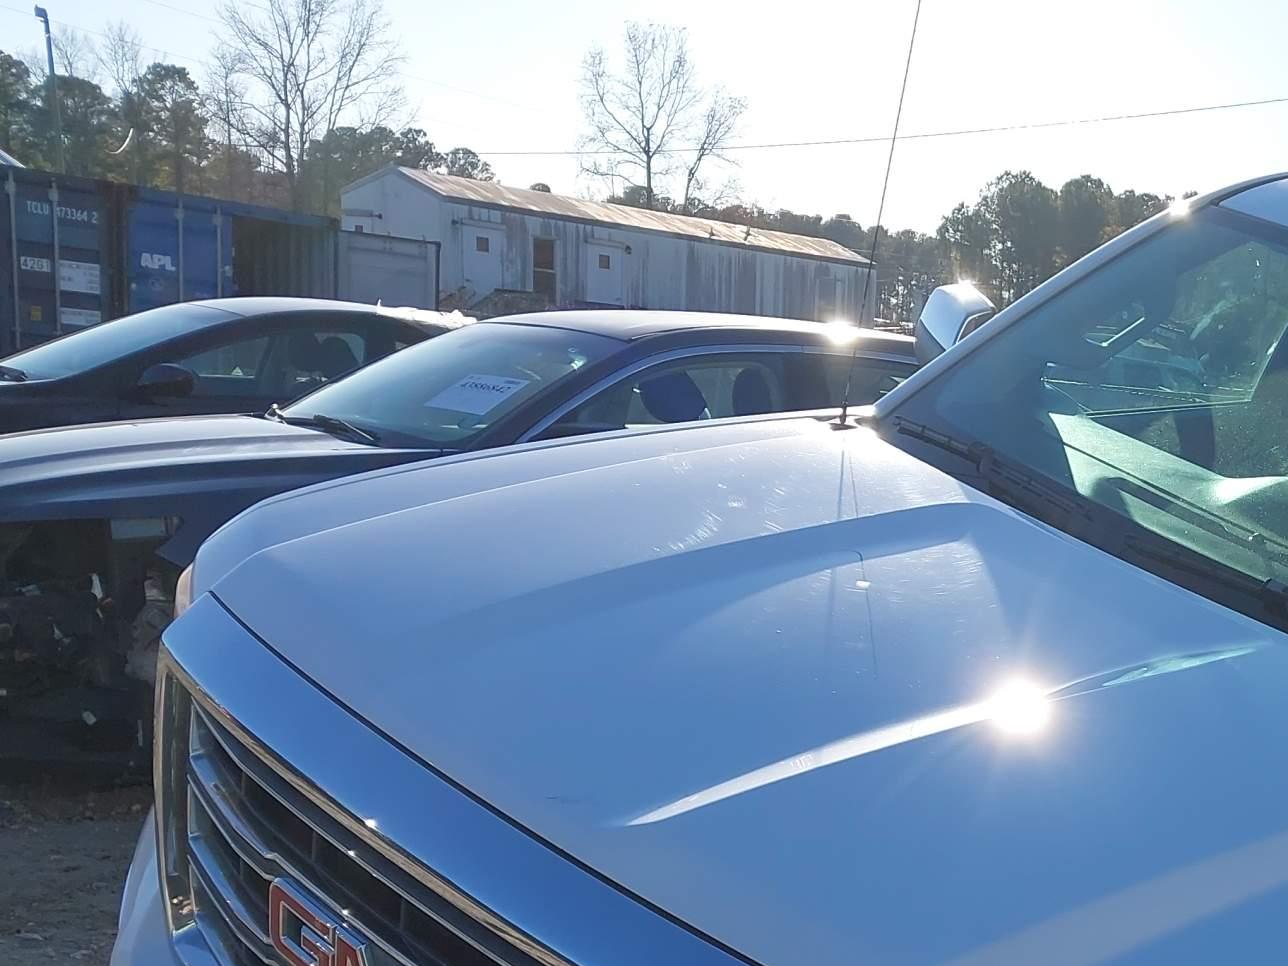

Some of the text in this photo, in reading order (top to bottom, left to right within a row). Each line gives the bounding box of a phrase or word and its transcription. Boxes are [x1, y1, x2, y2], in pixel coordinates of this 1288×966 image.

[26, 200, 49, 215] TCLU
[91, 211, 98, 224] 2
[140, 253, 176, 271] APL
